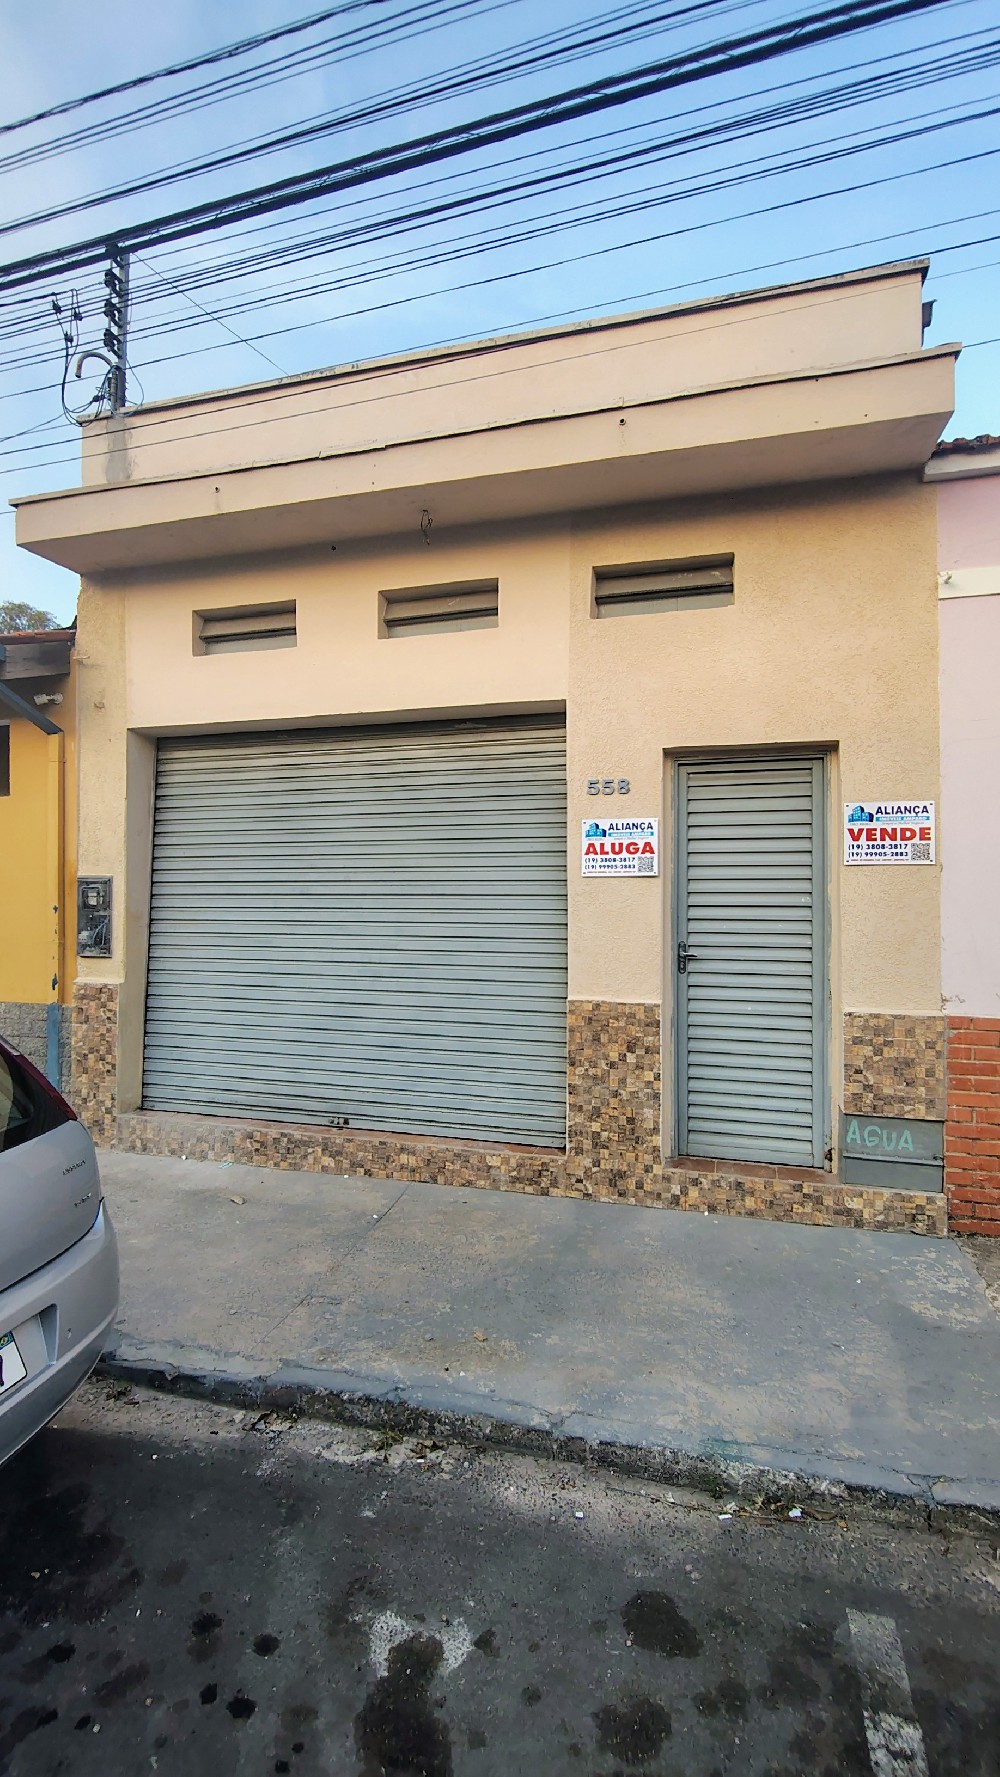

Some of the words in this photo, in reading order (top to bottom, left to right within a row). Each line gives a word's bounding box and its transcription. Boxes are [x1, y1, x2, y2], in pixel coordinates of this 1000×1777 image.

[587, 779, 630, 796] 558
[874, 805, 930, 817] ALIANÇA
[608, 822, 654, 833] ALIANÇA
[847, 826, 932, 842] VENDE
[584, 841, 656, 856] ALUGA
[848, 843, 864, 851] (19)
[848, 851, 863, 859] (19)
[846, 1119, 914, 1152] AGUA
